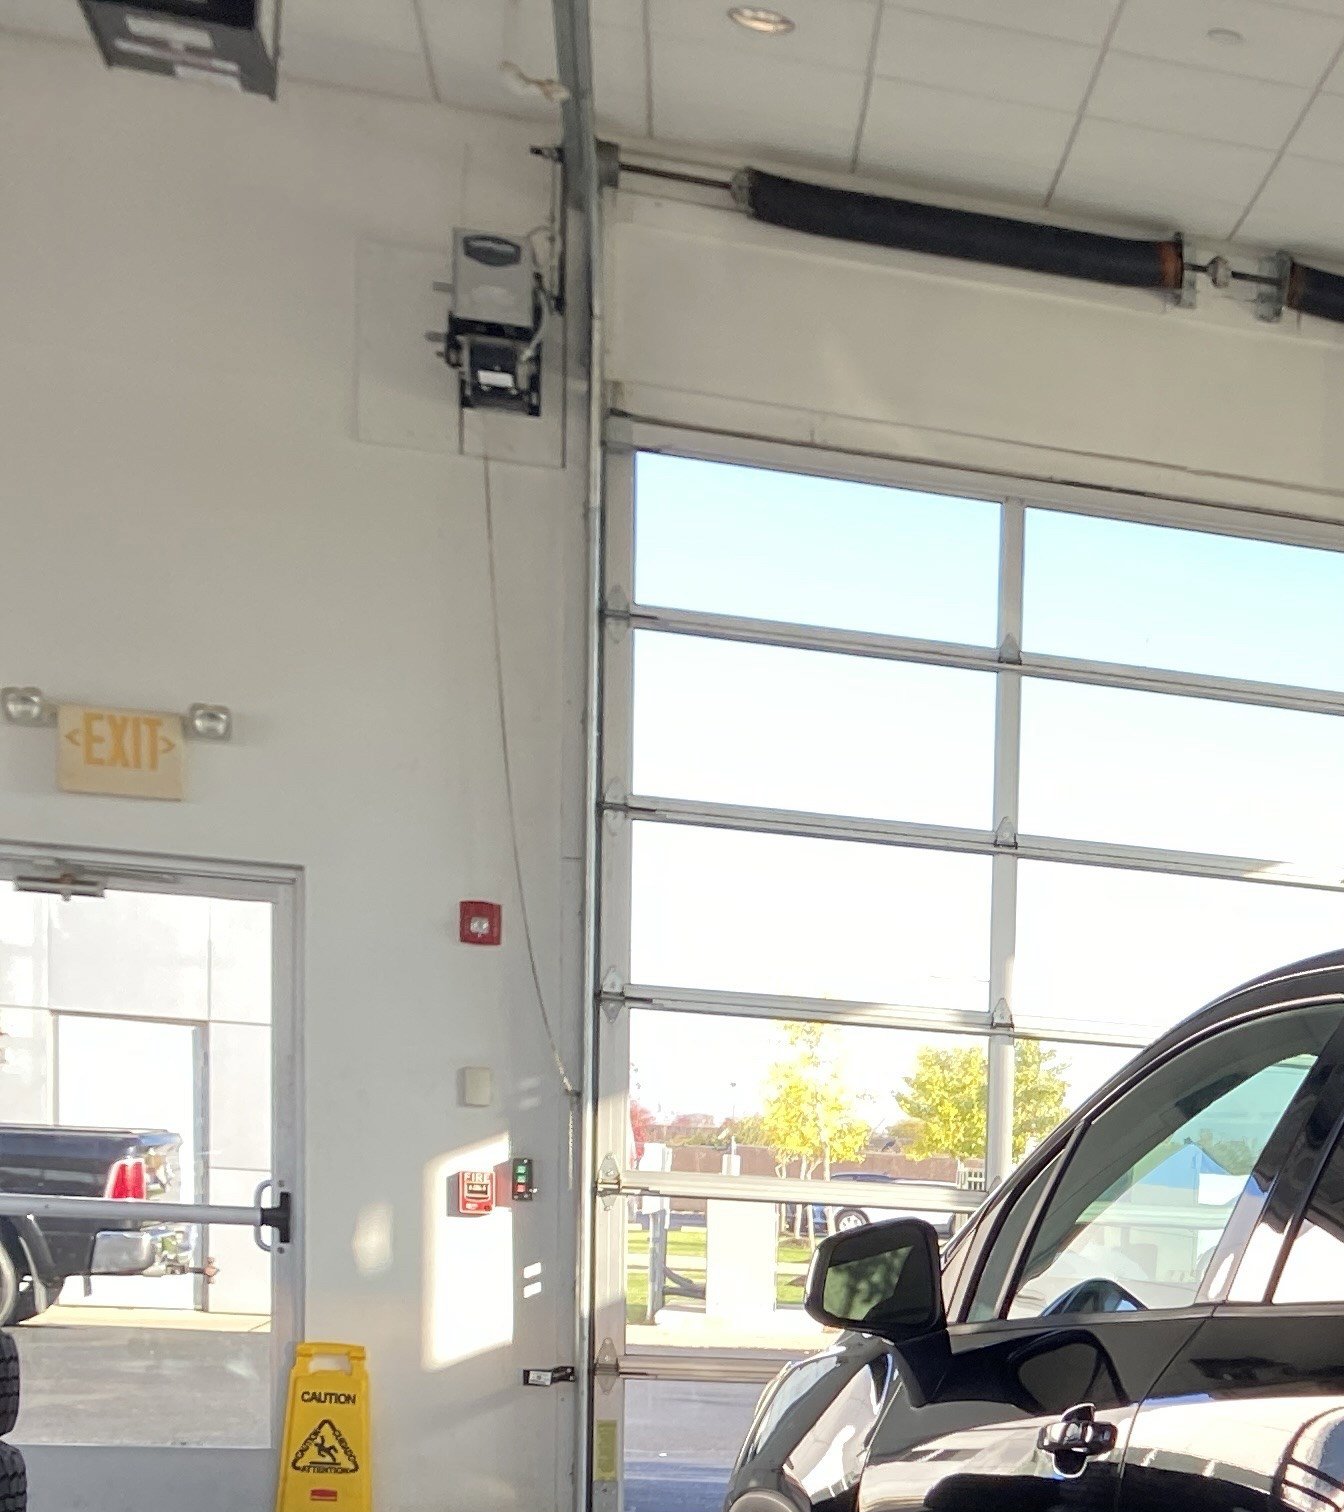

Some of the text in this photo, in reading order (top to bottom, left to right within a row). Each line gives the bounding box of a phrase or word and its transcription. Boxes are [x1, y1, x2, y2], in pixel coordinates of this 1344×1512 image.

[84, 712, 161, 771] EXIT
[464, 1172, 490, 1182] FIRE
[301, 1391, 356, 1404] CAUTION
